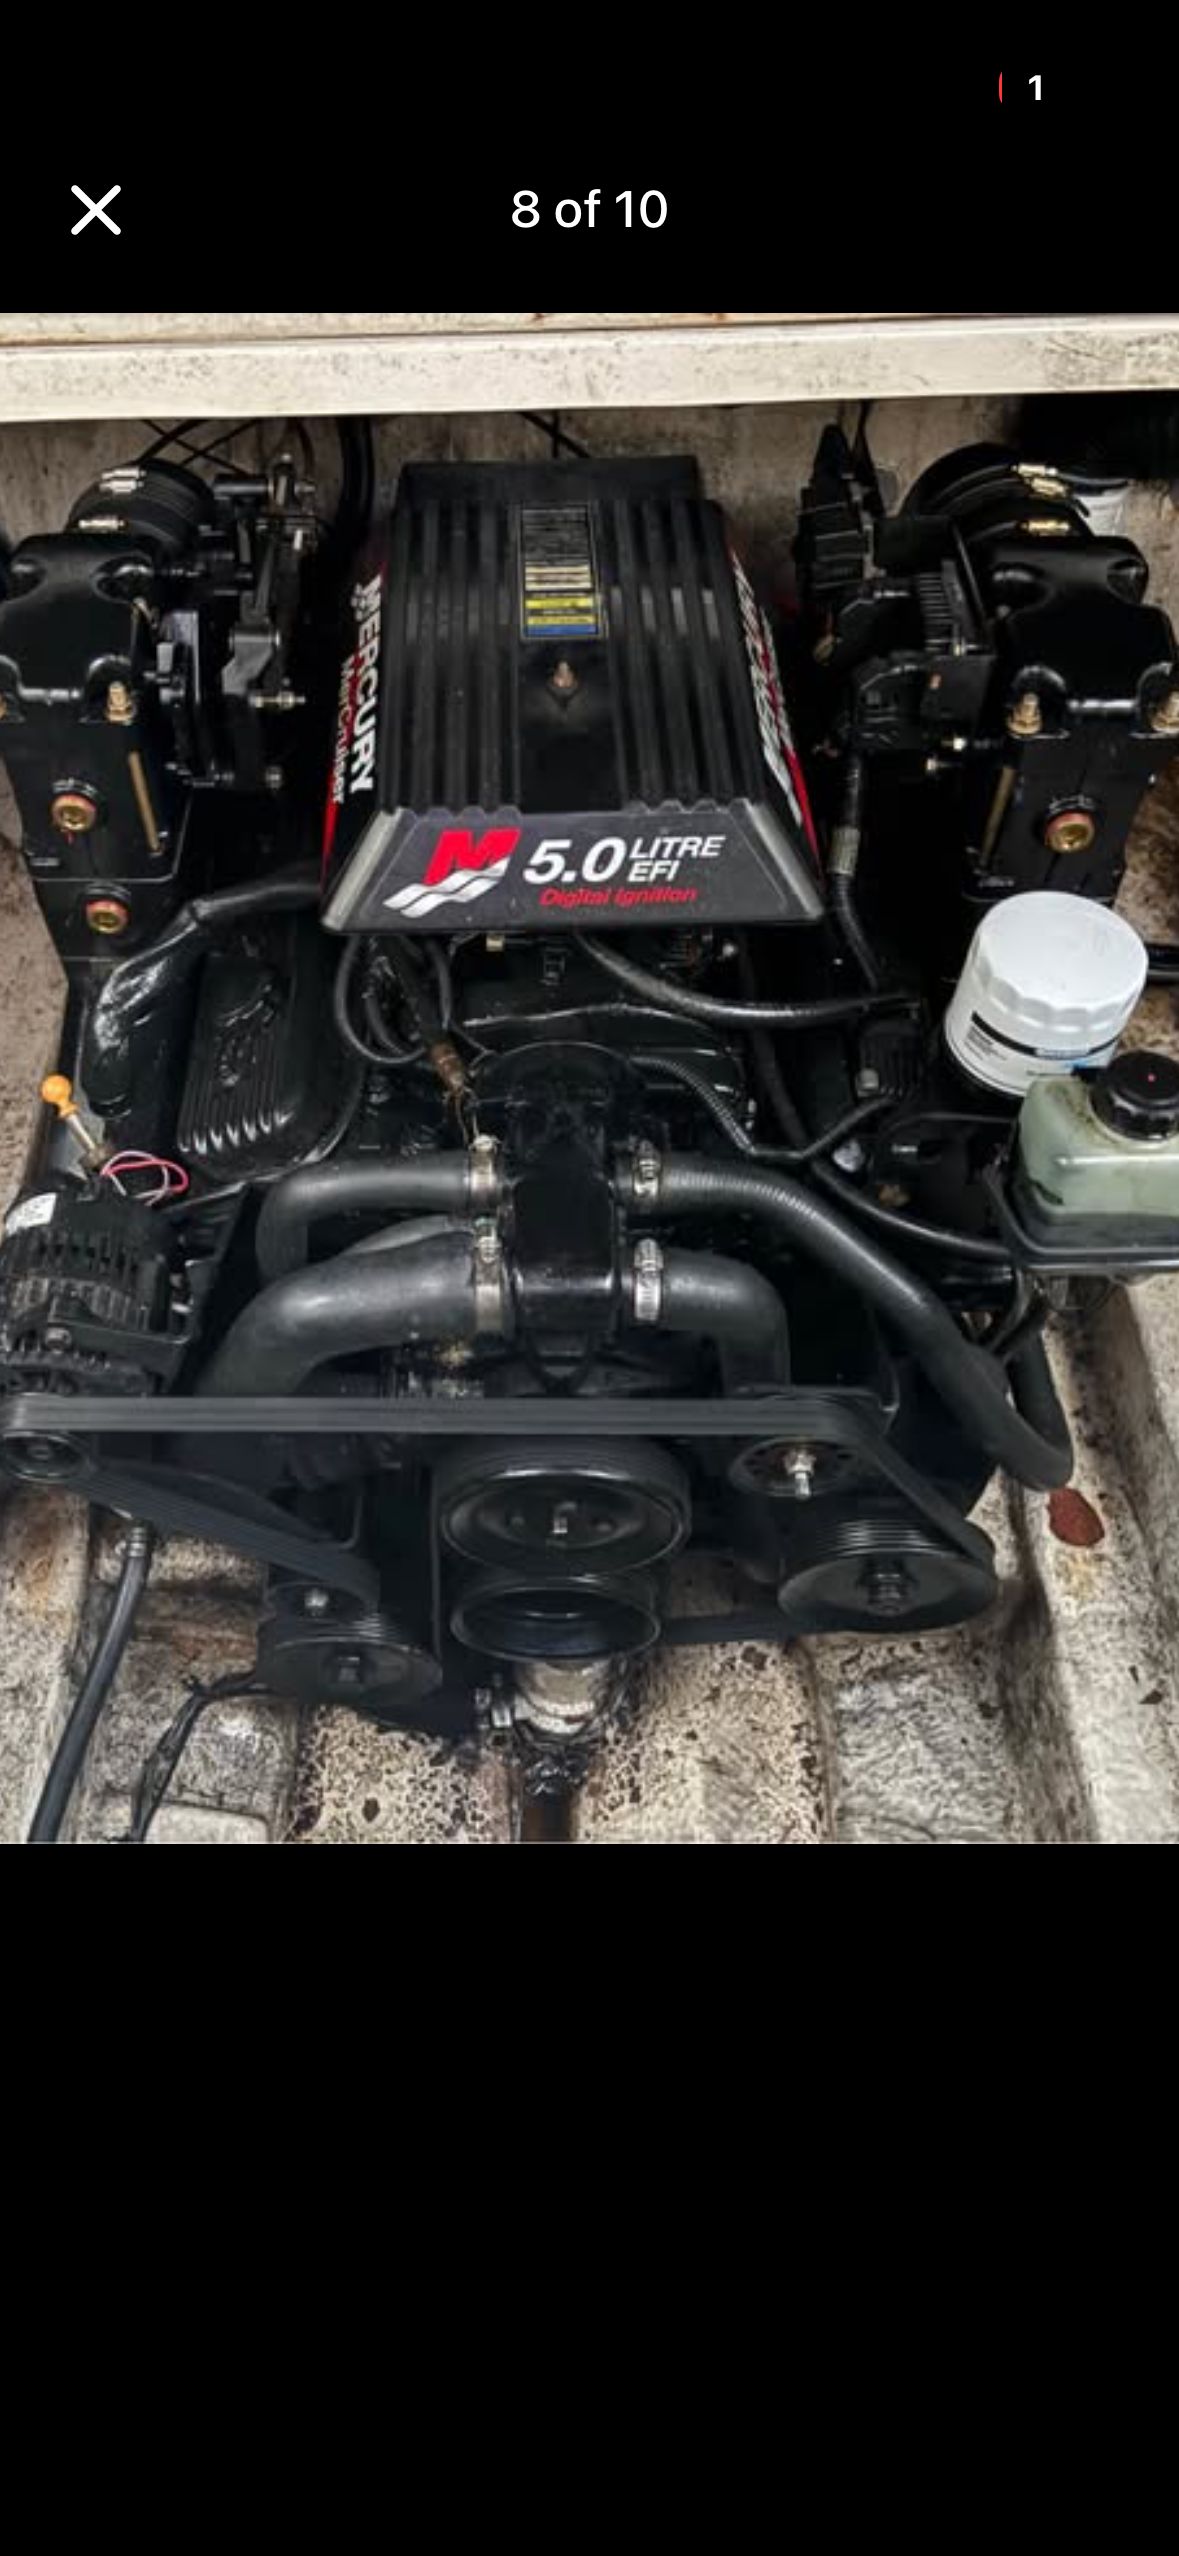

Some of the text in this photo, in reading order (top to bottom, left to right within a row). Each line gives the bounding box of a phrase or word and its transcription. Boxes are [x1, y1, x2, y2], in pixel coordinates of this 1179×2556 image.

[350, 574, 382, 794] MERCURY
[629, 834, 726, 859] LITRE
[522, 836, 628, 884] 5.0
[628, 859, 680, 883] EFI
[539, 885, 698, 908] Digital Ignition
